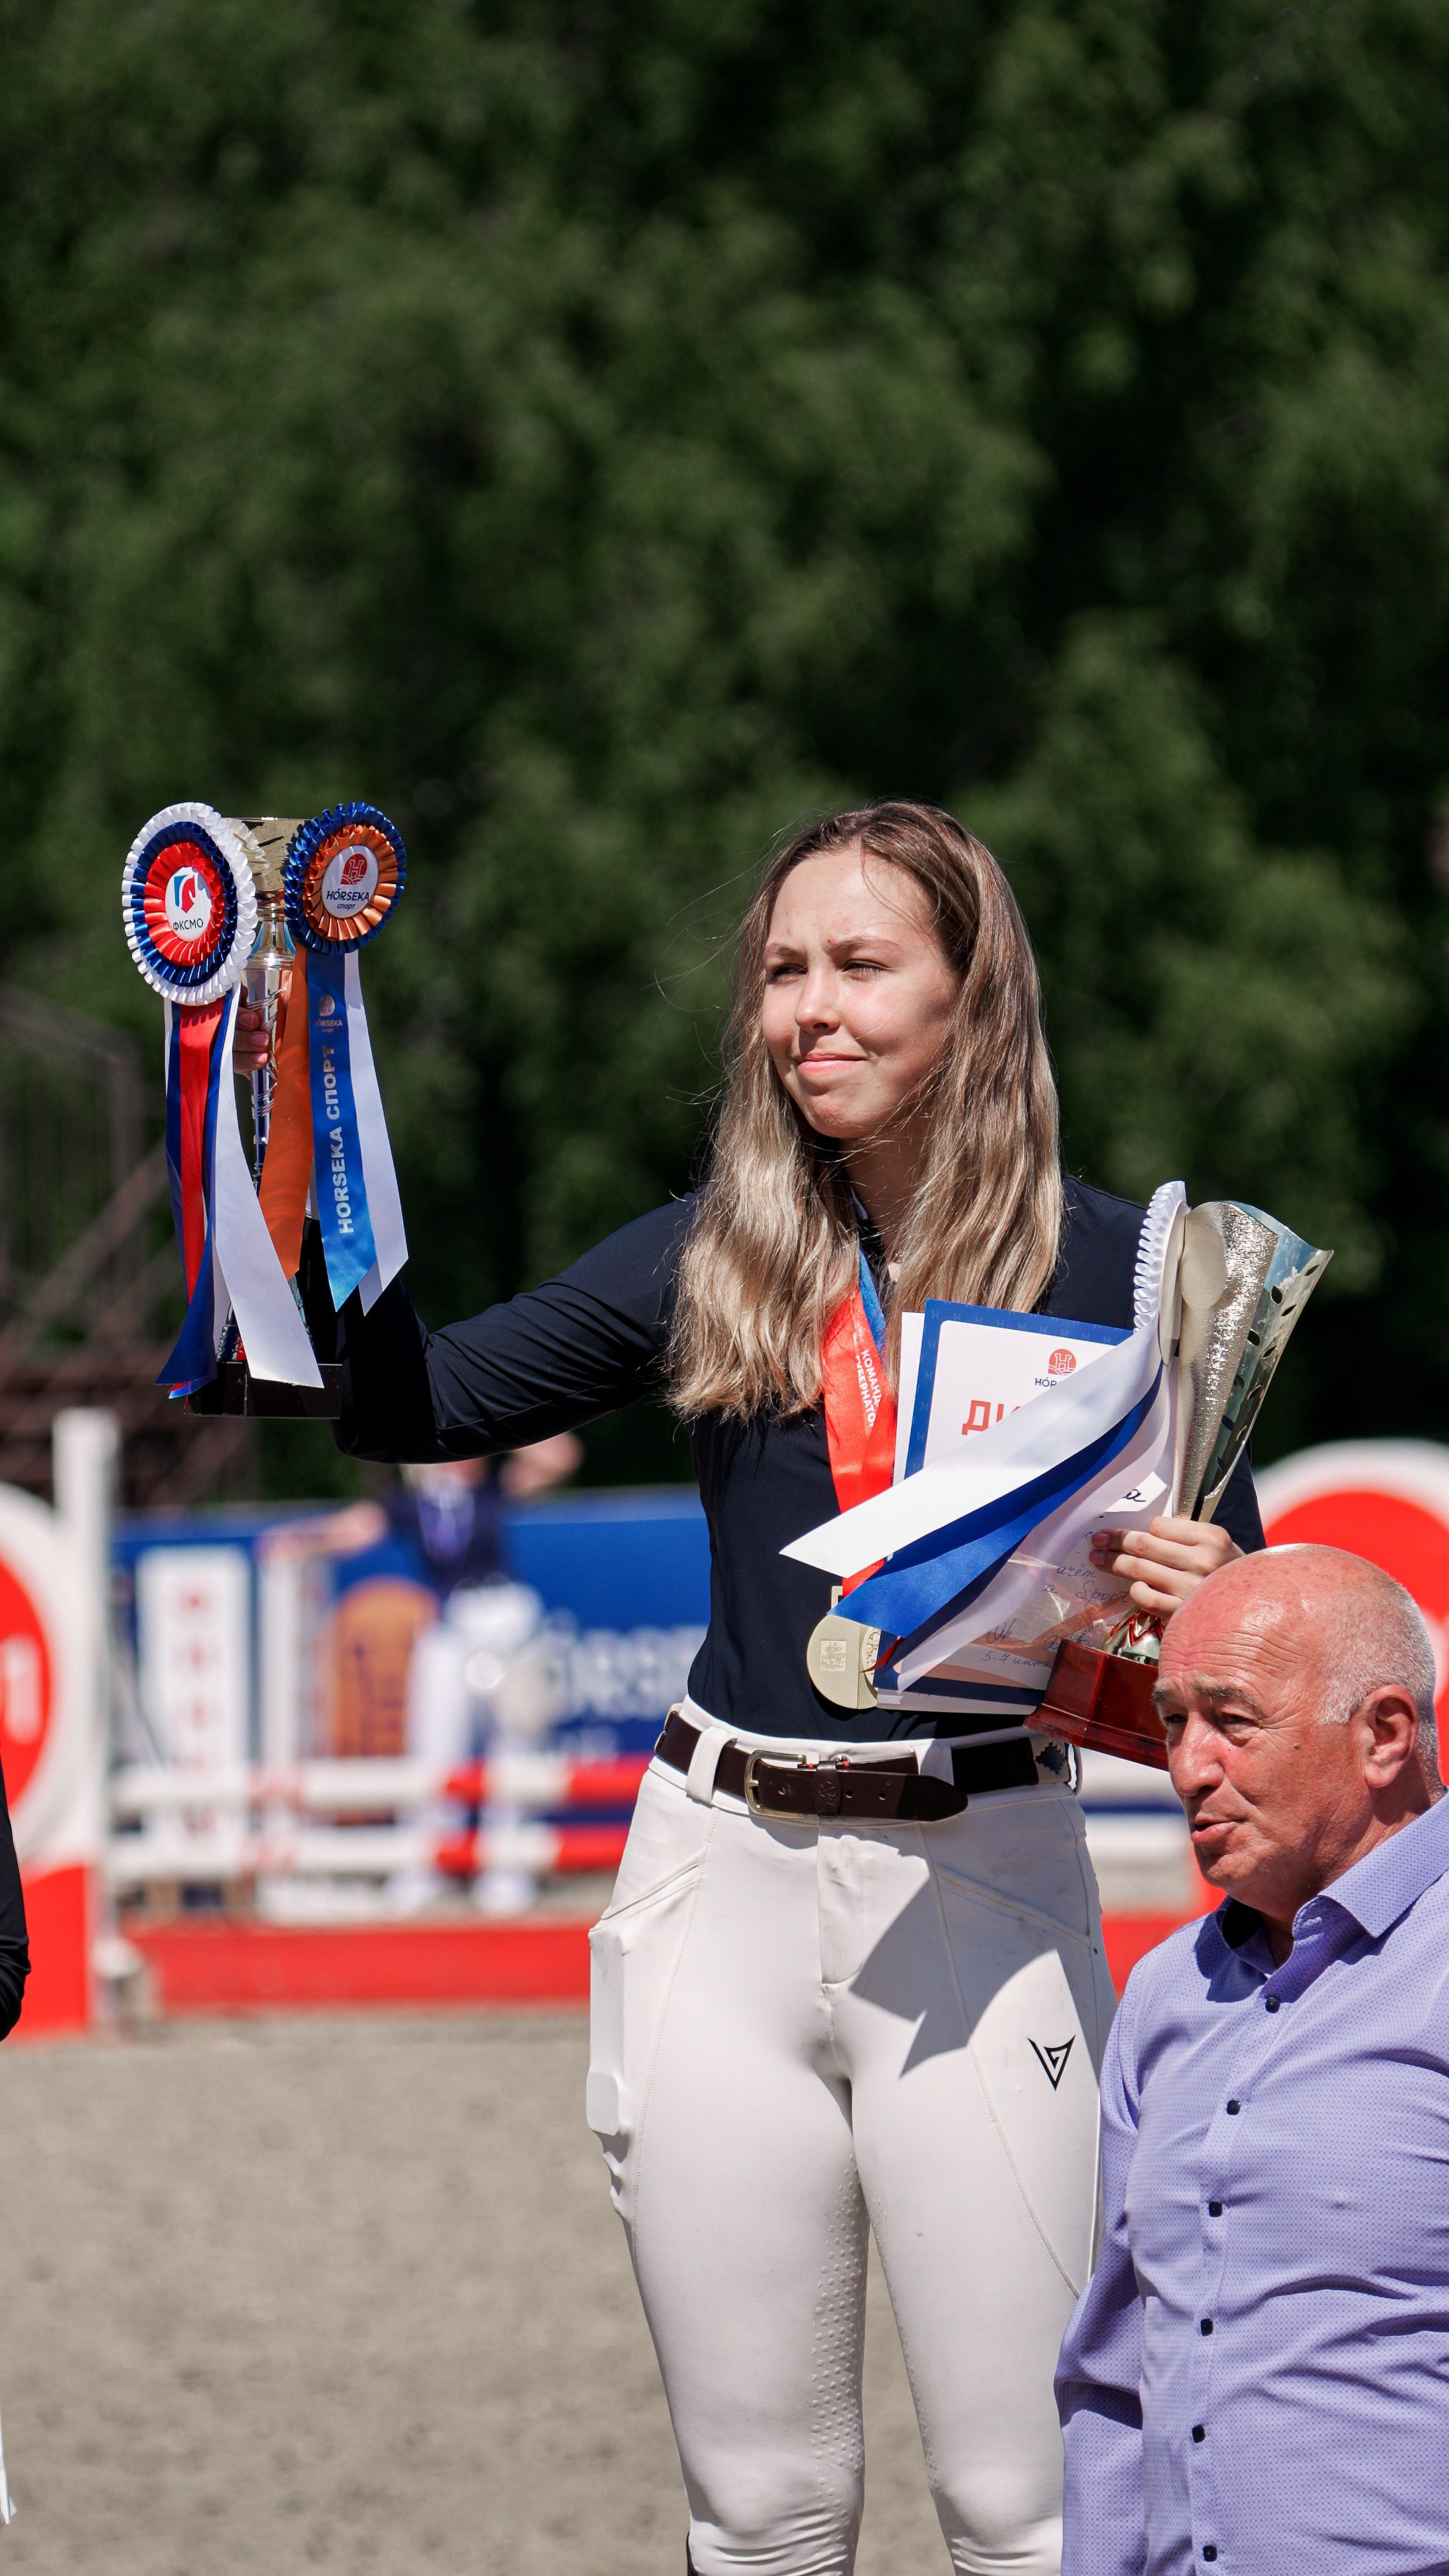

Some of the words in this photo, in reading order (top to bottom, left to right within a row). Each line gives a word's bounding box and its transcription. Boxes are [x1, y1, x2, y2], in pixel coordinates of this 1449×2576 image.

[173, 918, 204, 930] ФКСМО
[326, 888, 370, 901] HÓRSEKA
[323, 1045, 340, 1120] СПОРТ
[330, 1126, 354, 1234] HORSEKA
[855, 1354, 876, 1427] ГУБЕРНАТО
[861, 1349, 881, 1407] КОМАНД
